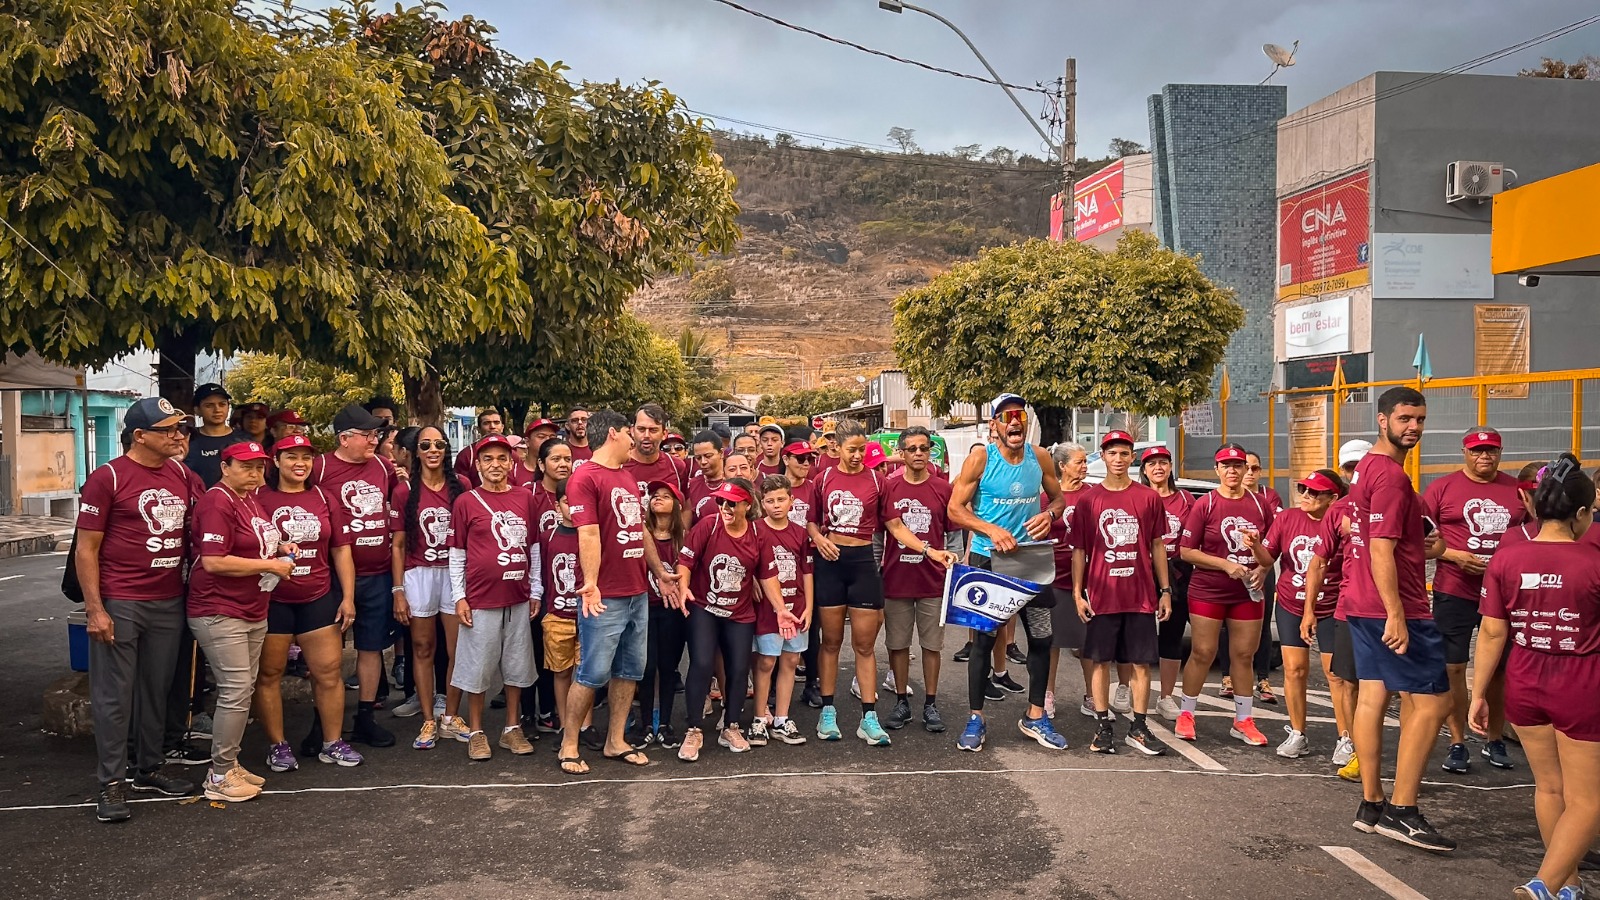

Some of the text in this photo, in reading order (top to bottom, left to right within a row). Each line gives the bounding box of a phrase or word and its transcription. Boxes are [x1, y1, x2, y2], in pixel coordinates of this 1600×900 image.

[1302, 200, 1347, 233] CNA
[1290, 316, 1342, 335] bem estar
[1541, 574, 1563, 584] CDL
[706, 605, 730, 617] Ricardo
